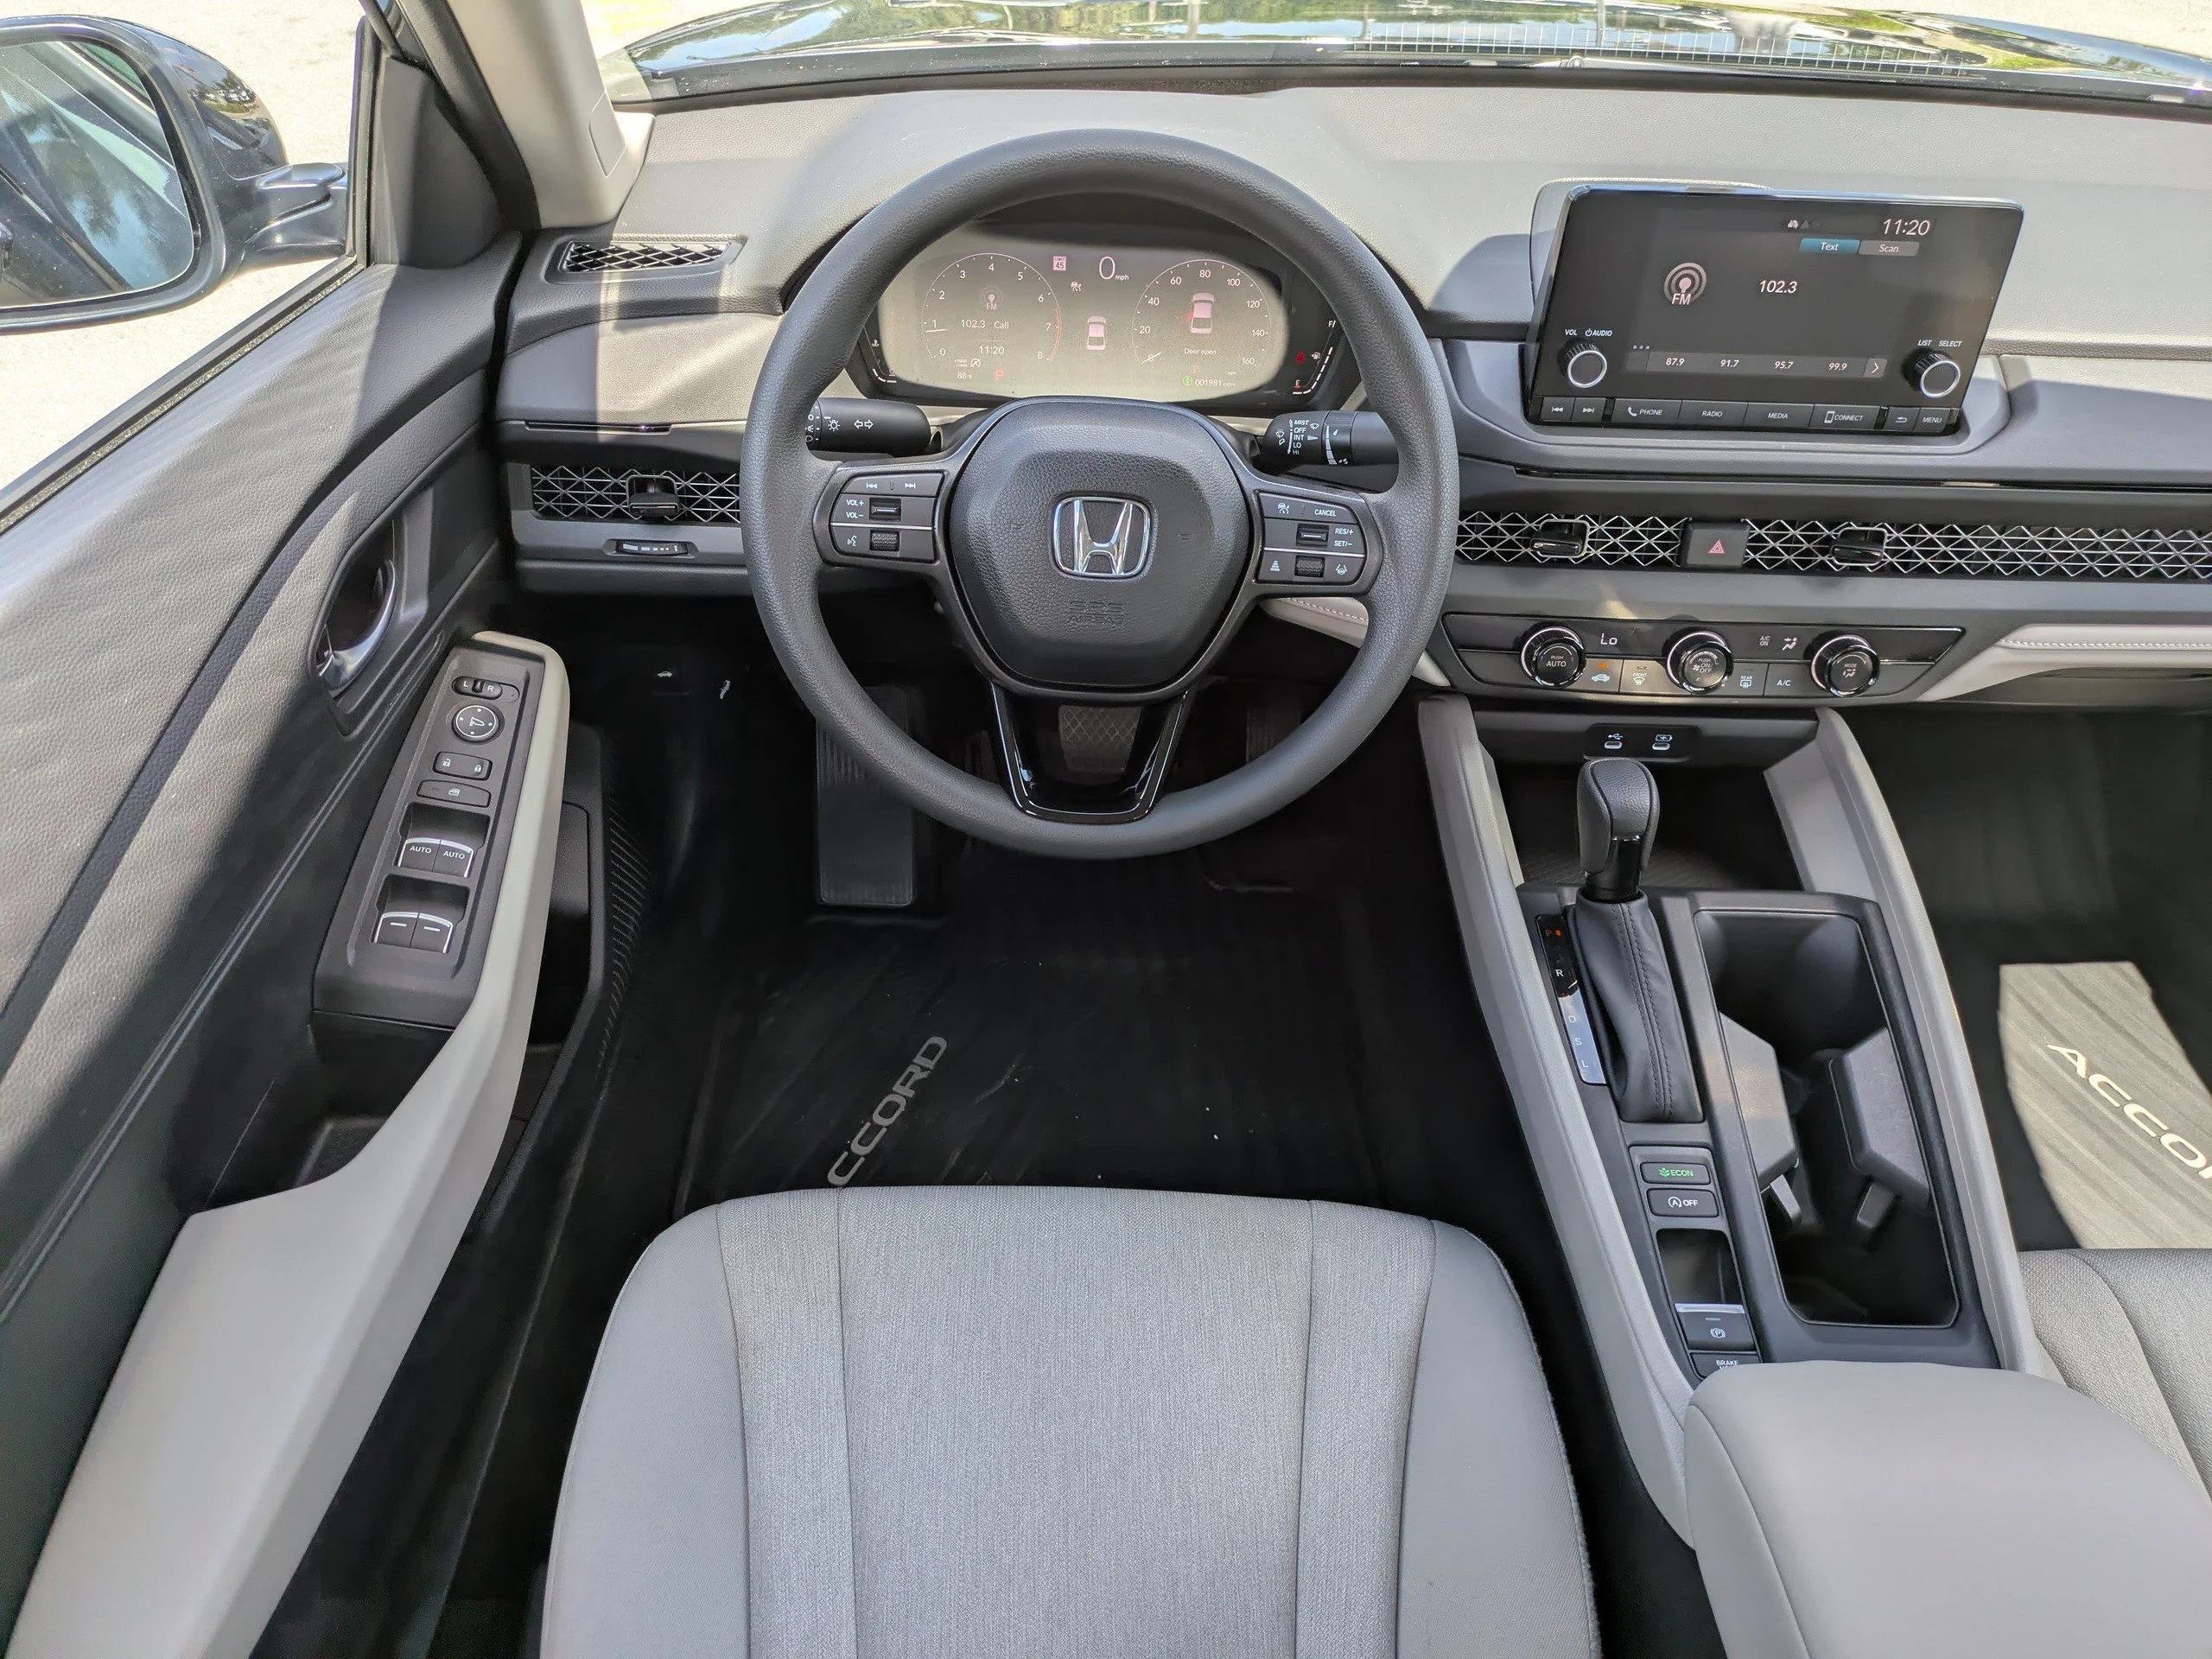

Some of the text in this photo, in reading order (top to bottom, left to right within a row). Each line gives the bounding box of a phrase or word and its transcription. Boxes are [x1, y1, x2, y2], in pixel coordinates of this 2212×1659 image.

[1883, 219, 1930, 236] 11:20
[1821, 242, 1839, 251] Text
[1878, 244, 1898, 253] Scan
[988, 263, 995, 271] 4
[1099, 256, 1116, 280] 0
[960, 270, 966, 279] 3
[1017, 272, 1023, 281] 5
[1199, 270, 1211, 278] 80
[1170, 276, 1181, 285] 60
[1226, 278, 1240, 287] 100
[1759, 280, 1797, 294] 102.3
[938, 291, 945, 300] 2
[1038, 294, 1045, 303] 6
[1671, 293, 1691, 305] FM
[1148, 297, 1160, 306] 40
[1247, 300, 1260, 308] 120
[932, 320, 937, 328] 1
[961, 320, 1009, 329] 102.3 Call
[1140, 326, 1151, 334] 20
[1252, 328, 1265, 337] 140
[940, 347, 946, 356] 0
[979, 346, 1005, 355] 11:20
[1037, 351, 1043, 359] 8
[1665, 358, 1847, 371] 87.9 91.7 95.7 99.9
[1600, 632, 1618, 645] Lo
[410, 845, 432, 855] AUTO
[442, 849, 465, 860] AUTO
[1555, 969, 1564, 977] R
[1581, 1059, 1589, 1068] L
[827, 1036, 947, 1186] CCORD
[2046, 1044, 2212, 1179] ACCO
